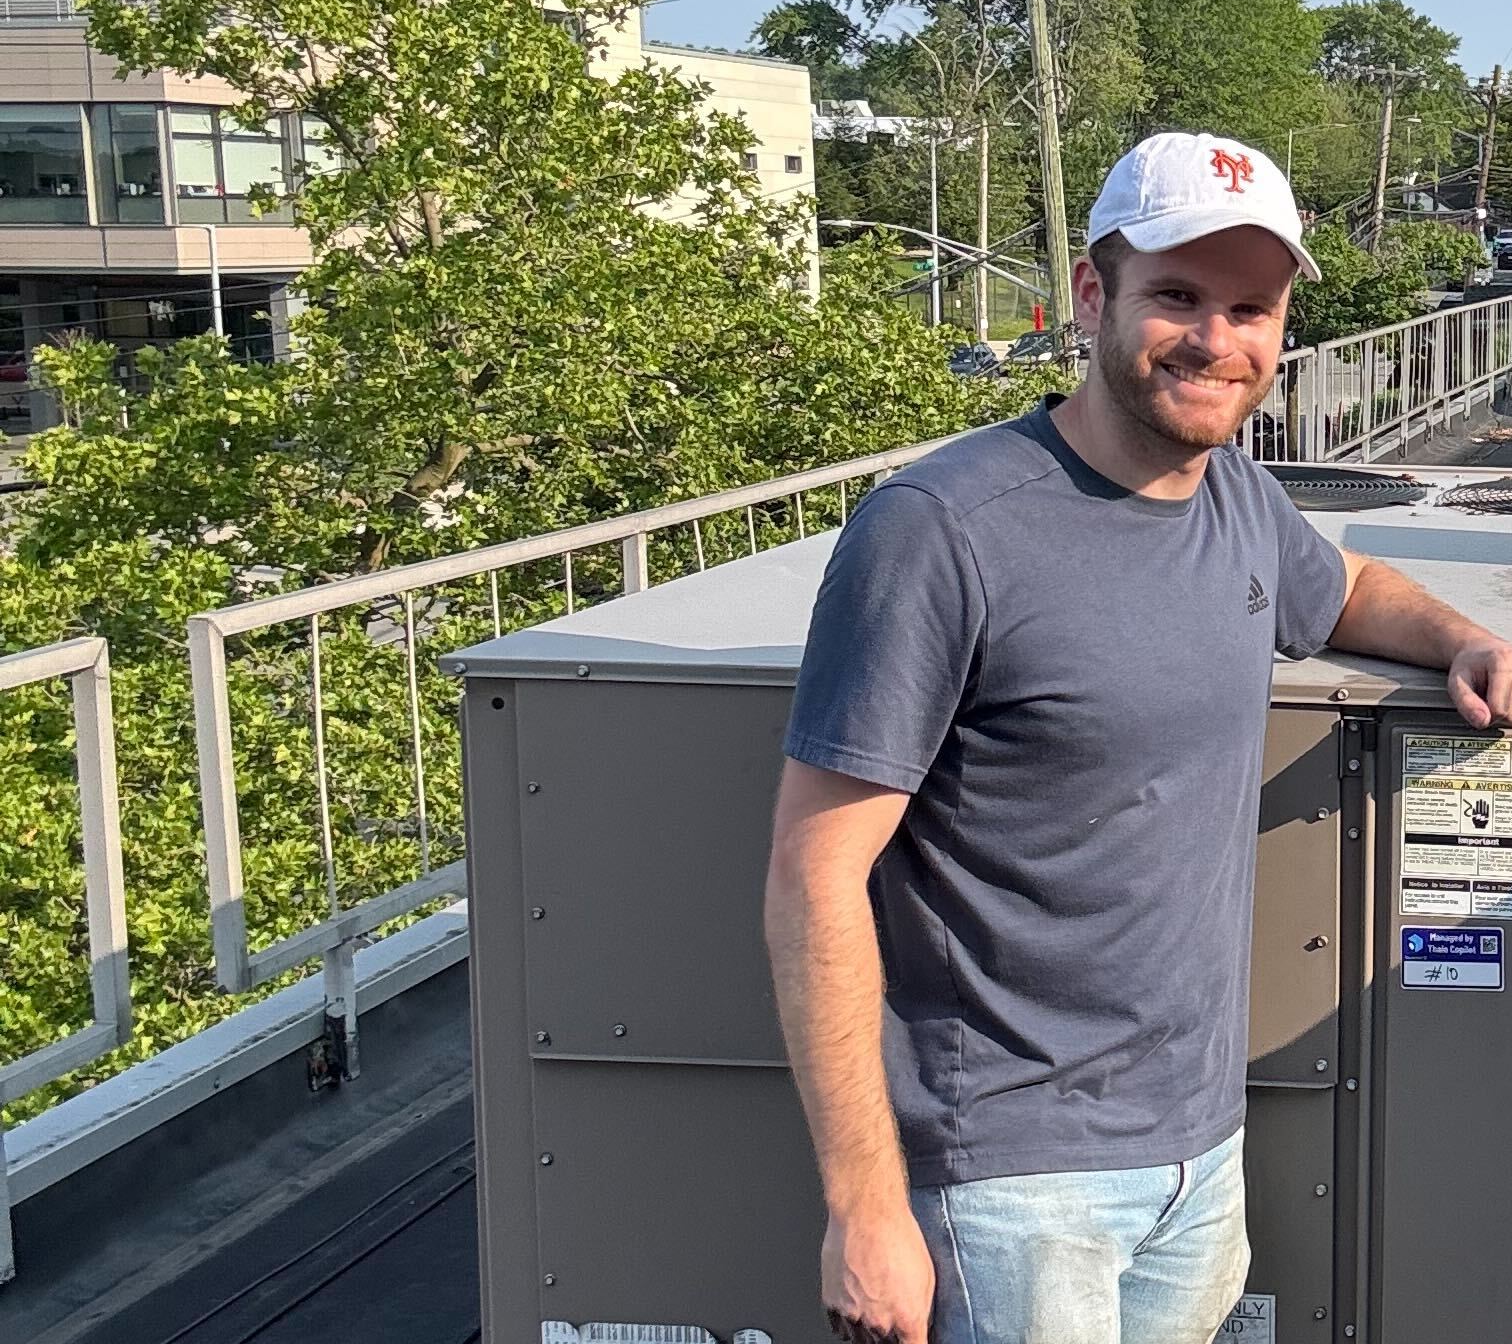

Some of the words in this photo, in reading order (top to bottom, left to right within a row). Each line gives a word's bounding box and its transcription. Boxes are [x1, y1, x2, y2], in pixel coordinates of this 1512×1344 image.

[1411, 779, 1454, 789] WARNING
[1457, 836, 1500, 846] Important
[1429, 932, 1464, 944] Managed
[1464, 934, 1474, 945] by
[1449, 944, 1476, 955] Copilot
[1232, 1301, 1265, 1316] NLY
[1221, 1319, 1244, 1335] ND
